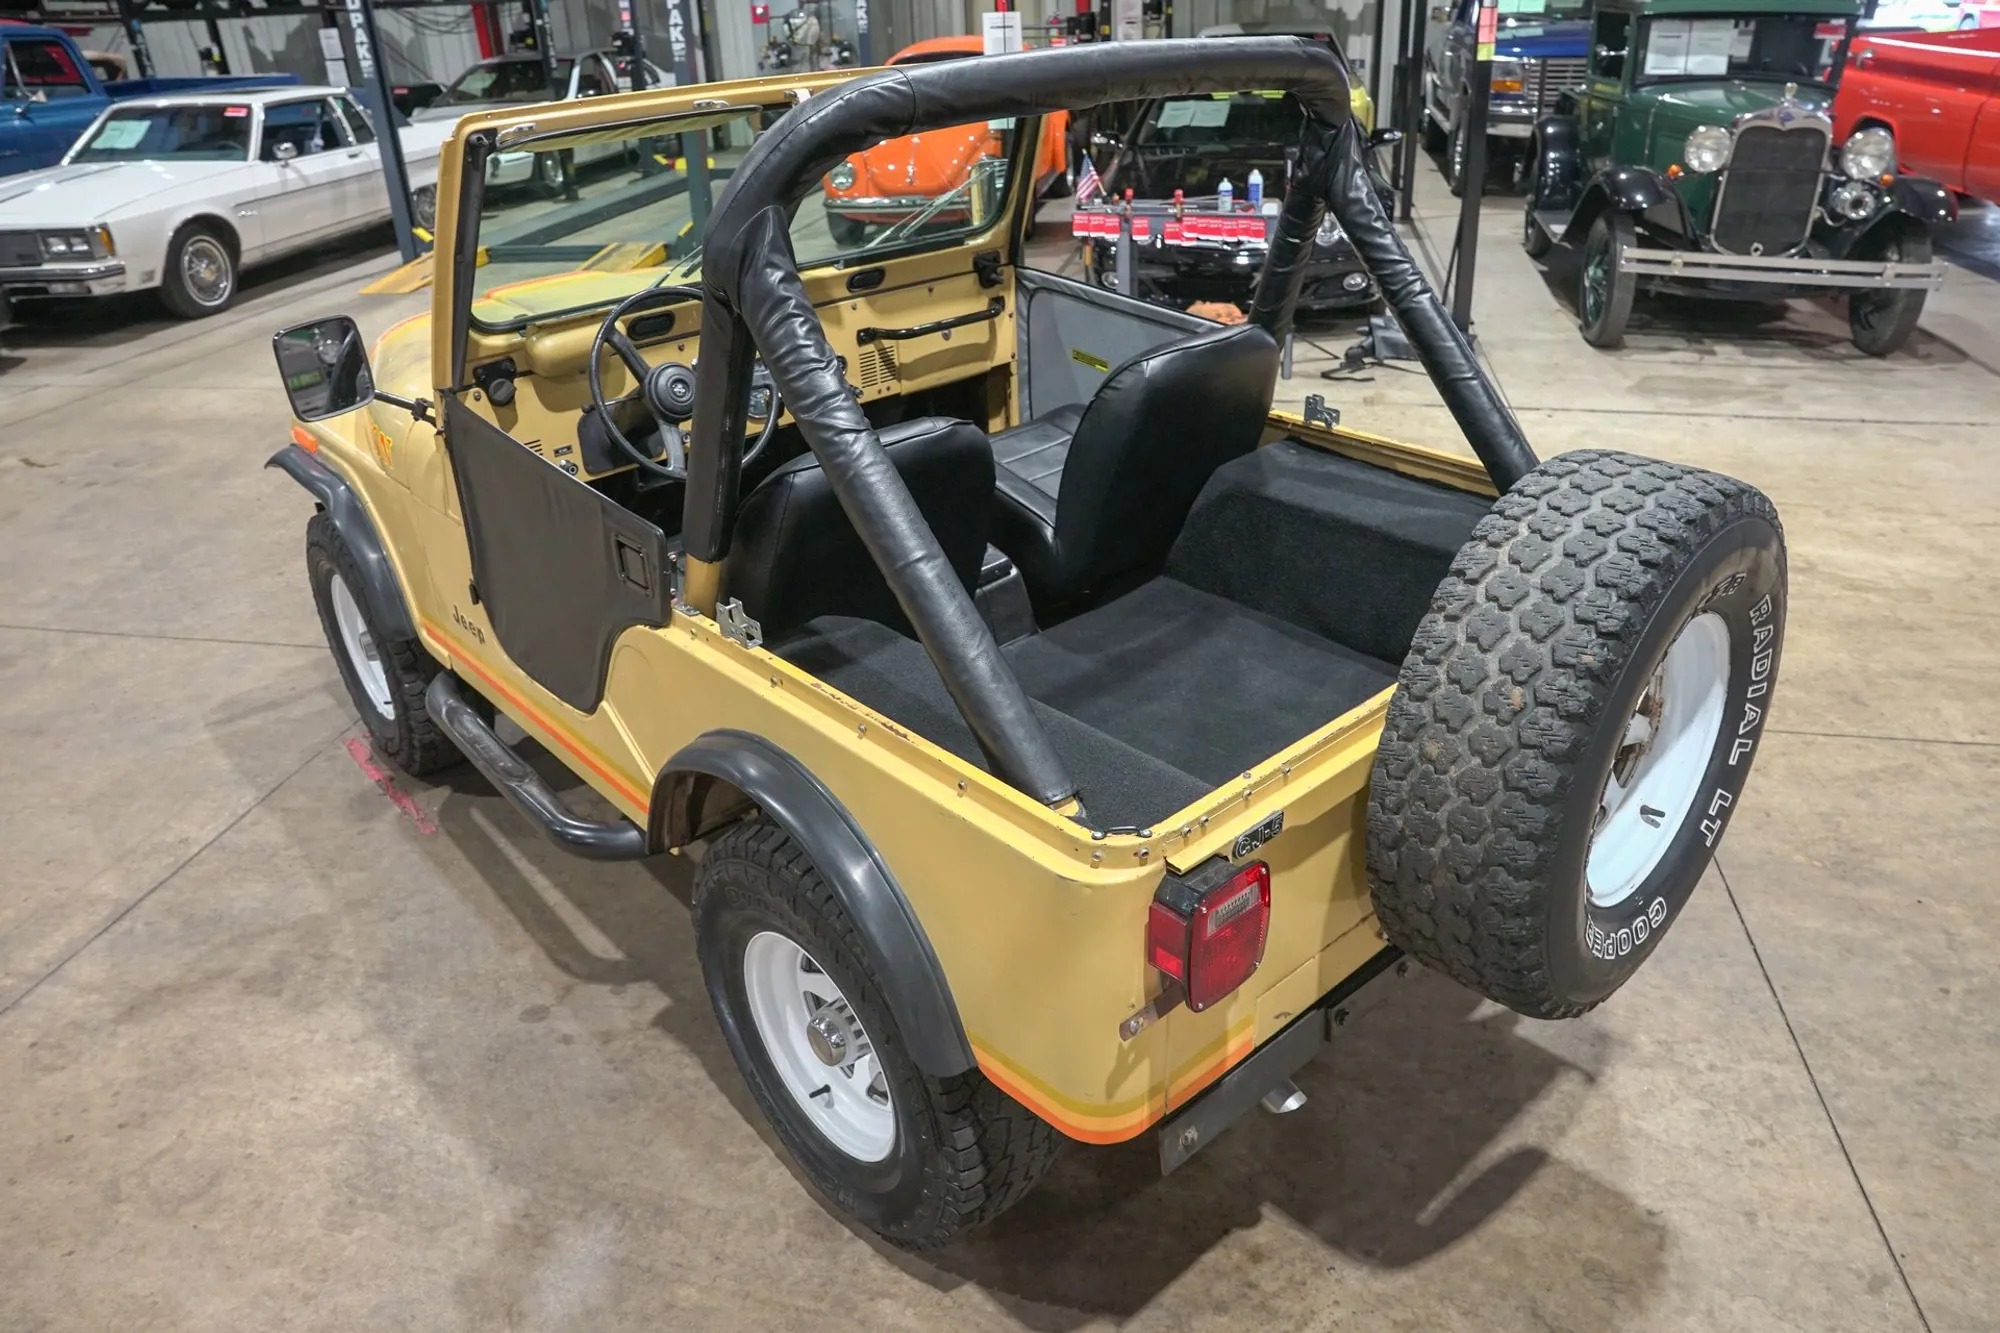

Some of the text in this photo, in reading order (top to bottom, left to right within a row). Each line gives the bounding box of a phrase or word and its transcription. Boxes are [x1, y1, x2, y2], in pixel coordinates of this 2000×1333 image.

[452, 604, 486, 645] Jeep
[1700, 593, 1774, 848] RADIAL LT
